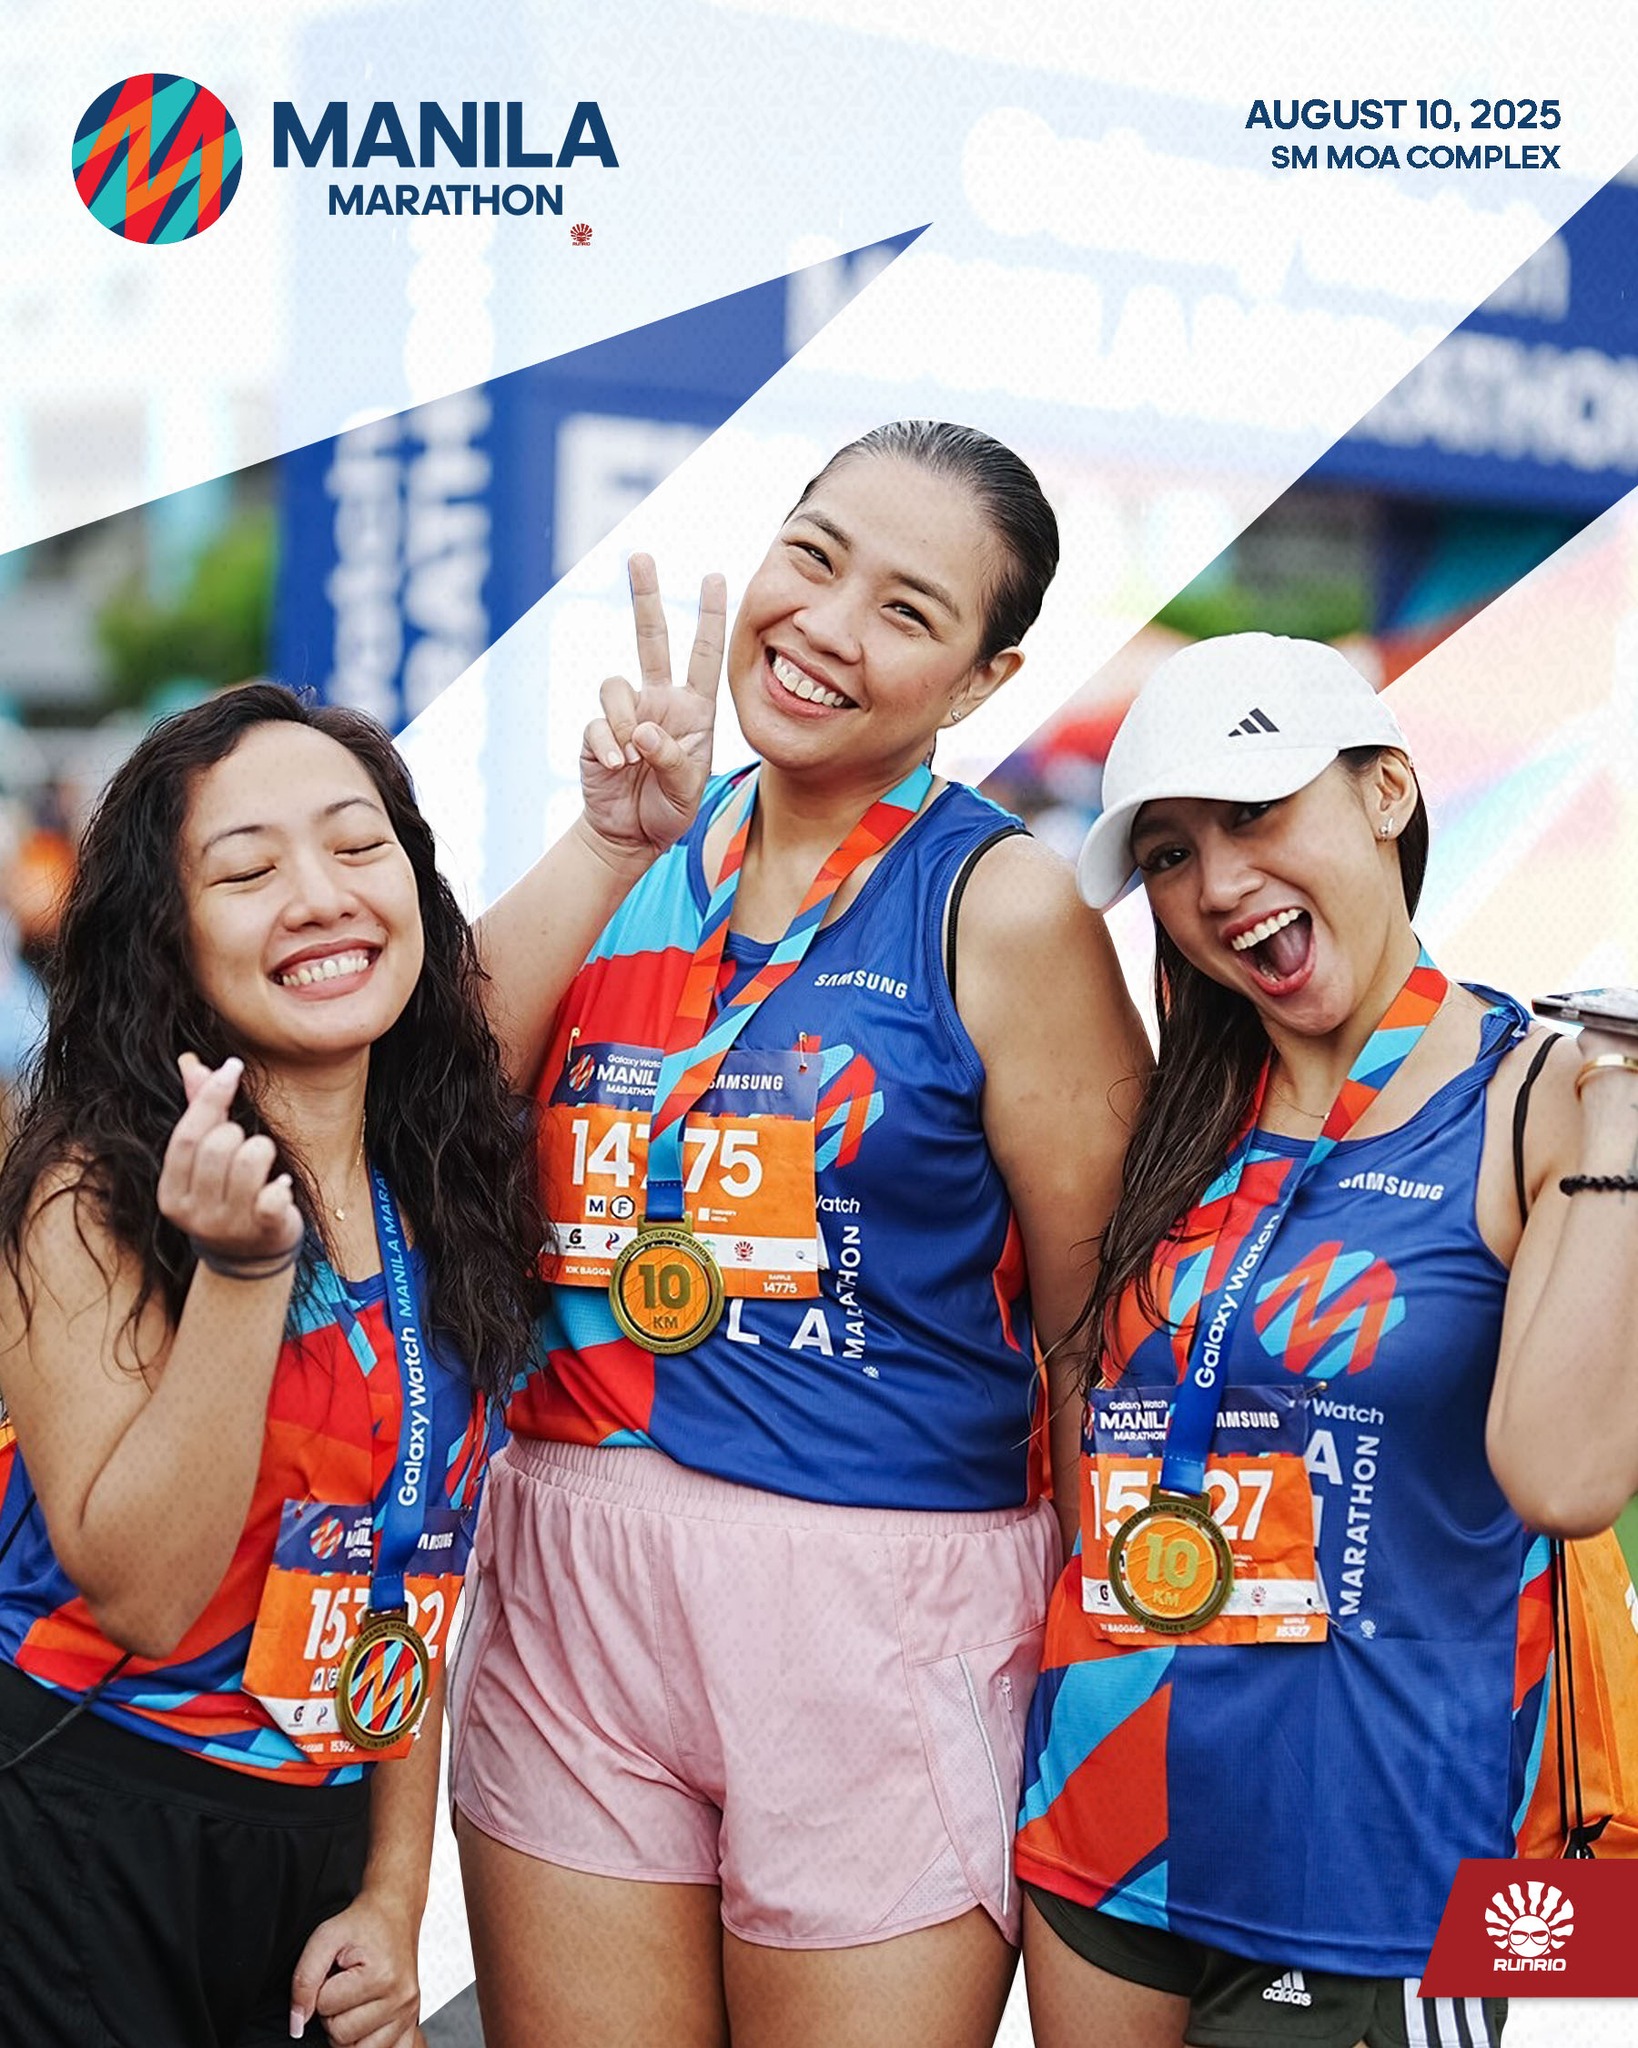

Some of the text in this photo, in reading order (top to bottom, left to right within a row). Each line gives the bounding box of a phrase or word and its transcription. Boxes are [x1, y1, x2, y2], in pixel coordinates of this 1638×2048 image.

[813, 969, 909, 1000] SAMSUNG
[607, 1053, 662, 1068] Galaxy Watc
[596, 1064, 658, 1087] MANIL
[588, 1199, 628, 1216] M F
[580, 1265, 612, 1277] BAGGA
[637, 1263, 692, 1310] 10
[762, 1281, 799, 1294] 14775
[1194, 1214, 1280, 1389] Galaxy Watch
[652, 1315, 679, 1329] KM
[374, 1169, 431, 1507] Galaxy Watch MANILA MARAT
[1142, 1399, 1168, 1409] Watch
[1312, 1397, 1385, 1425] Watch
[1215, 1411, 1280, 1429] AMSUNG
[1089, 1468, 1274, 1541] 1527
[1338, 1434, 1381, 1617] MARATHON
[1145, 1532, 1200, 1590] 10
[1152, 1588, 1180, 1608] KM
[1261, 1987, 1313, 2008] adidas
